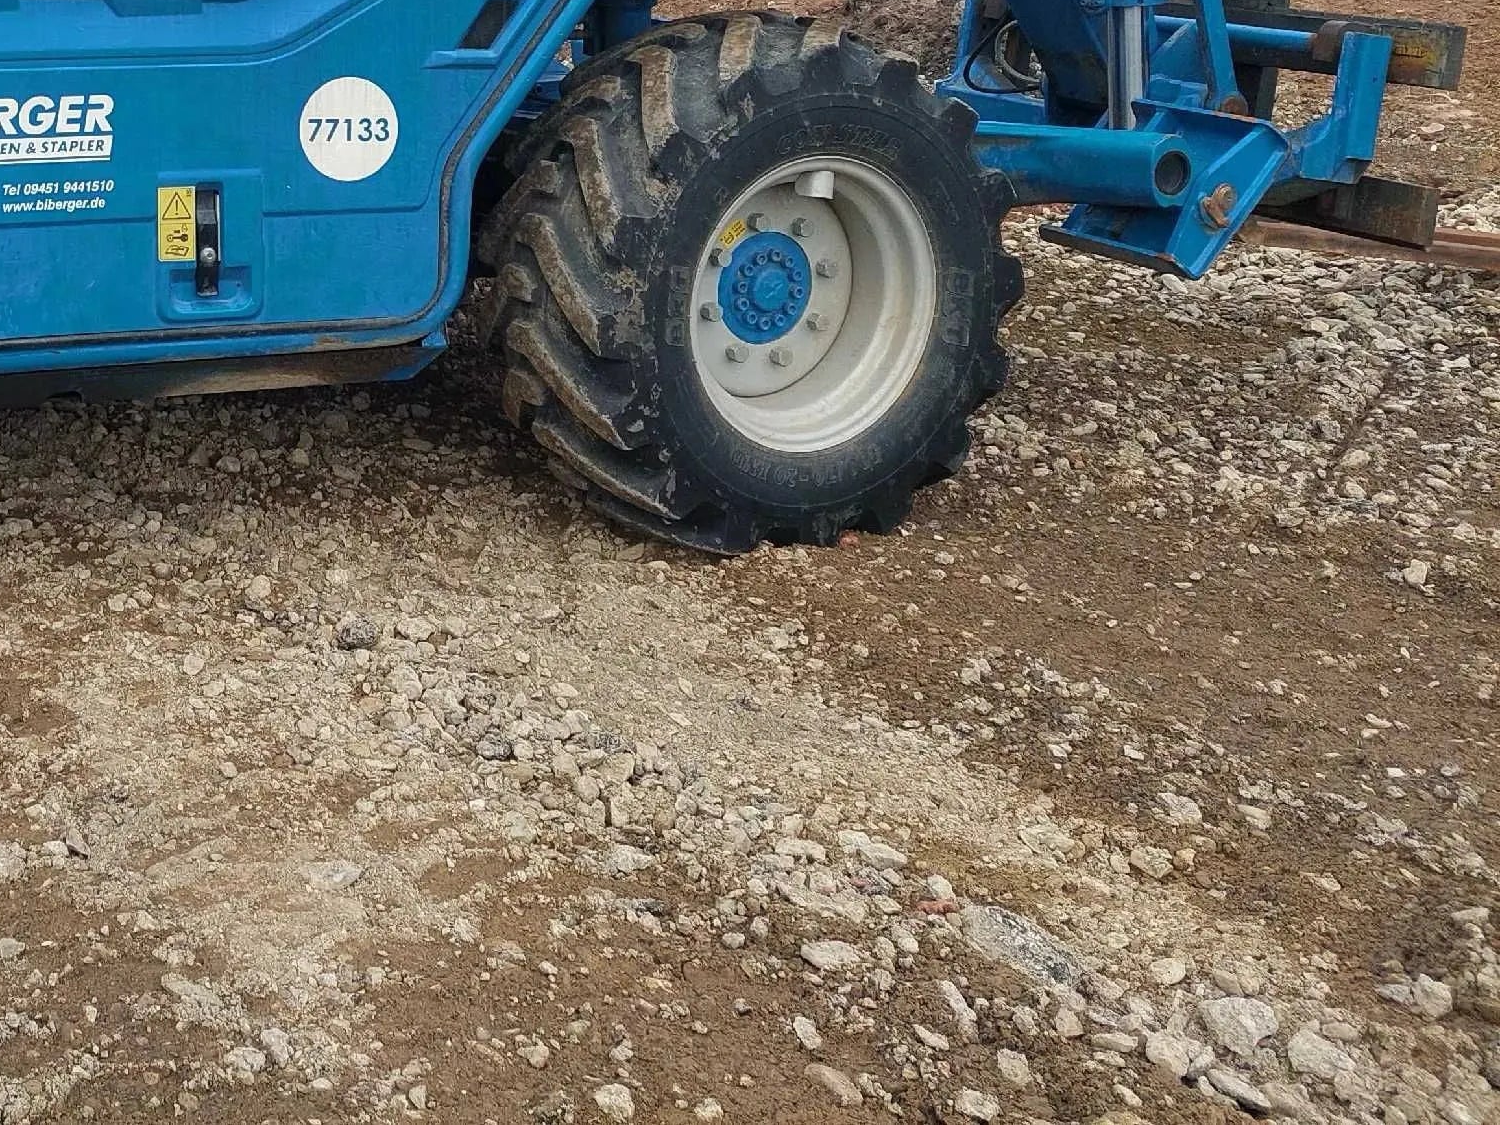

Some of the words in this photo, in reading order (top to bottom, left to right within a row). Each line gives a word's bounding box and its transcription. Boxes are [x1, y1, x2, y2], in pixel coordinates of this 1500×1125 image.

[307, 118, 390, 142] 77133
[26, 143, 37, 155] &
[41, 139, 106, 154] STAPLER
[2, 183, 20, 197] Tel
[23, 181, 59, 196] 09451
[63, 179, 115, 195] 9441510
[2, 197, 106, 214] www.biberger.de
